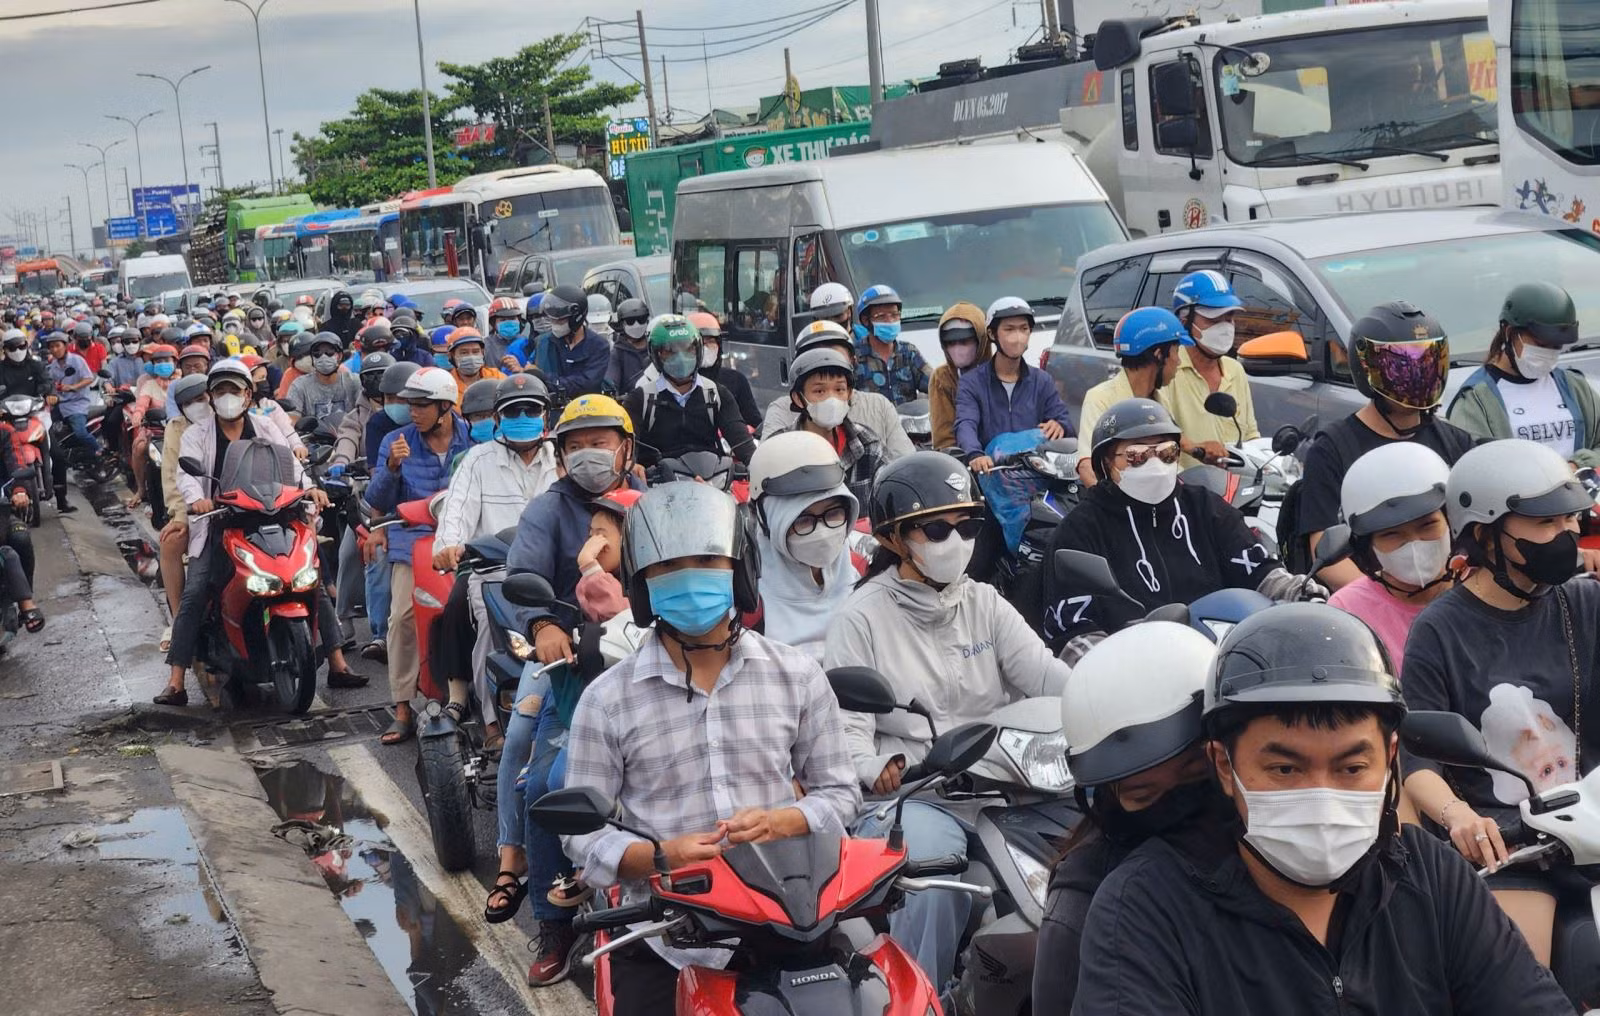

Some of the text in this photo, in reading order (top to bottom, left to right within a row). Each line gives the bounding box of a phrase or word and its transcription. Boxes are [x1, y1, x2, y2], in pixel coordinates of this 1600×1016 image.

[770, 143, 794, 165] XE
[1336, 179, 1484, 212] HYUNDAI
[790, 971, 839, 987] HONDA
